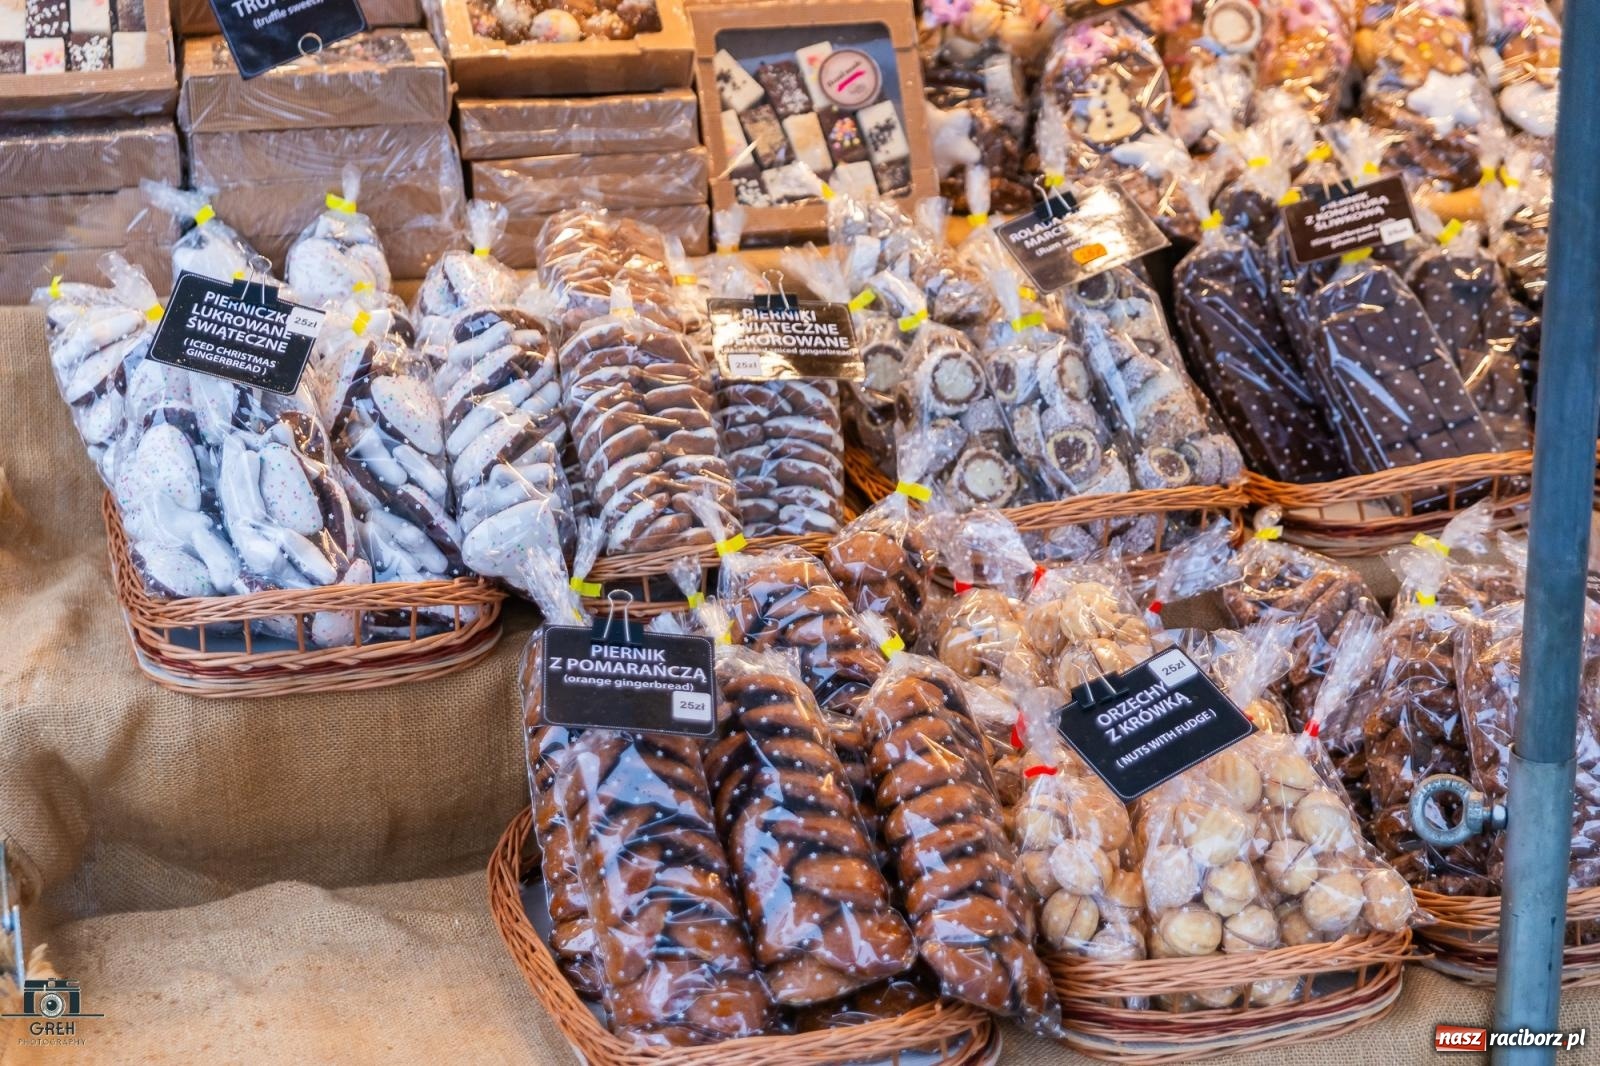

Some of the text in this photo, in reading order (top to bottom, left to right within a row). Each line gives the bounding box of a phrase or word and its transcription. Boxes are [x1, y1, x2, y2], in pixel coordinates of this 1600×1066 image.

[252, 8, 288, 30] (truffle
[204, 291, 288, 324] PIERNICZK
[186, 315, 289, 353] ŚWIĄTECZNE
[191, 303, 292, 340] LUKROWANE
[216, 345, 277, 368] CHRISTMAS
[591, 644, 665, 662] PIERNIK
[549, 656, 708, 683] Z POMARAŃCZĄ
[563, 673, 694, 692] (orange gingerbread)
[679, 700, 705, 711] 25zł
[1096, 681, 1169, 727] ORZECHY
[1105, 691, 1192, 743] Z KRÓWKĄ
[1149, 730, 1177, 749] WITH
